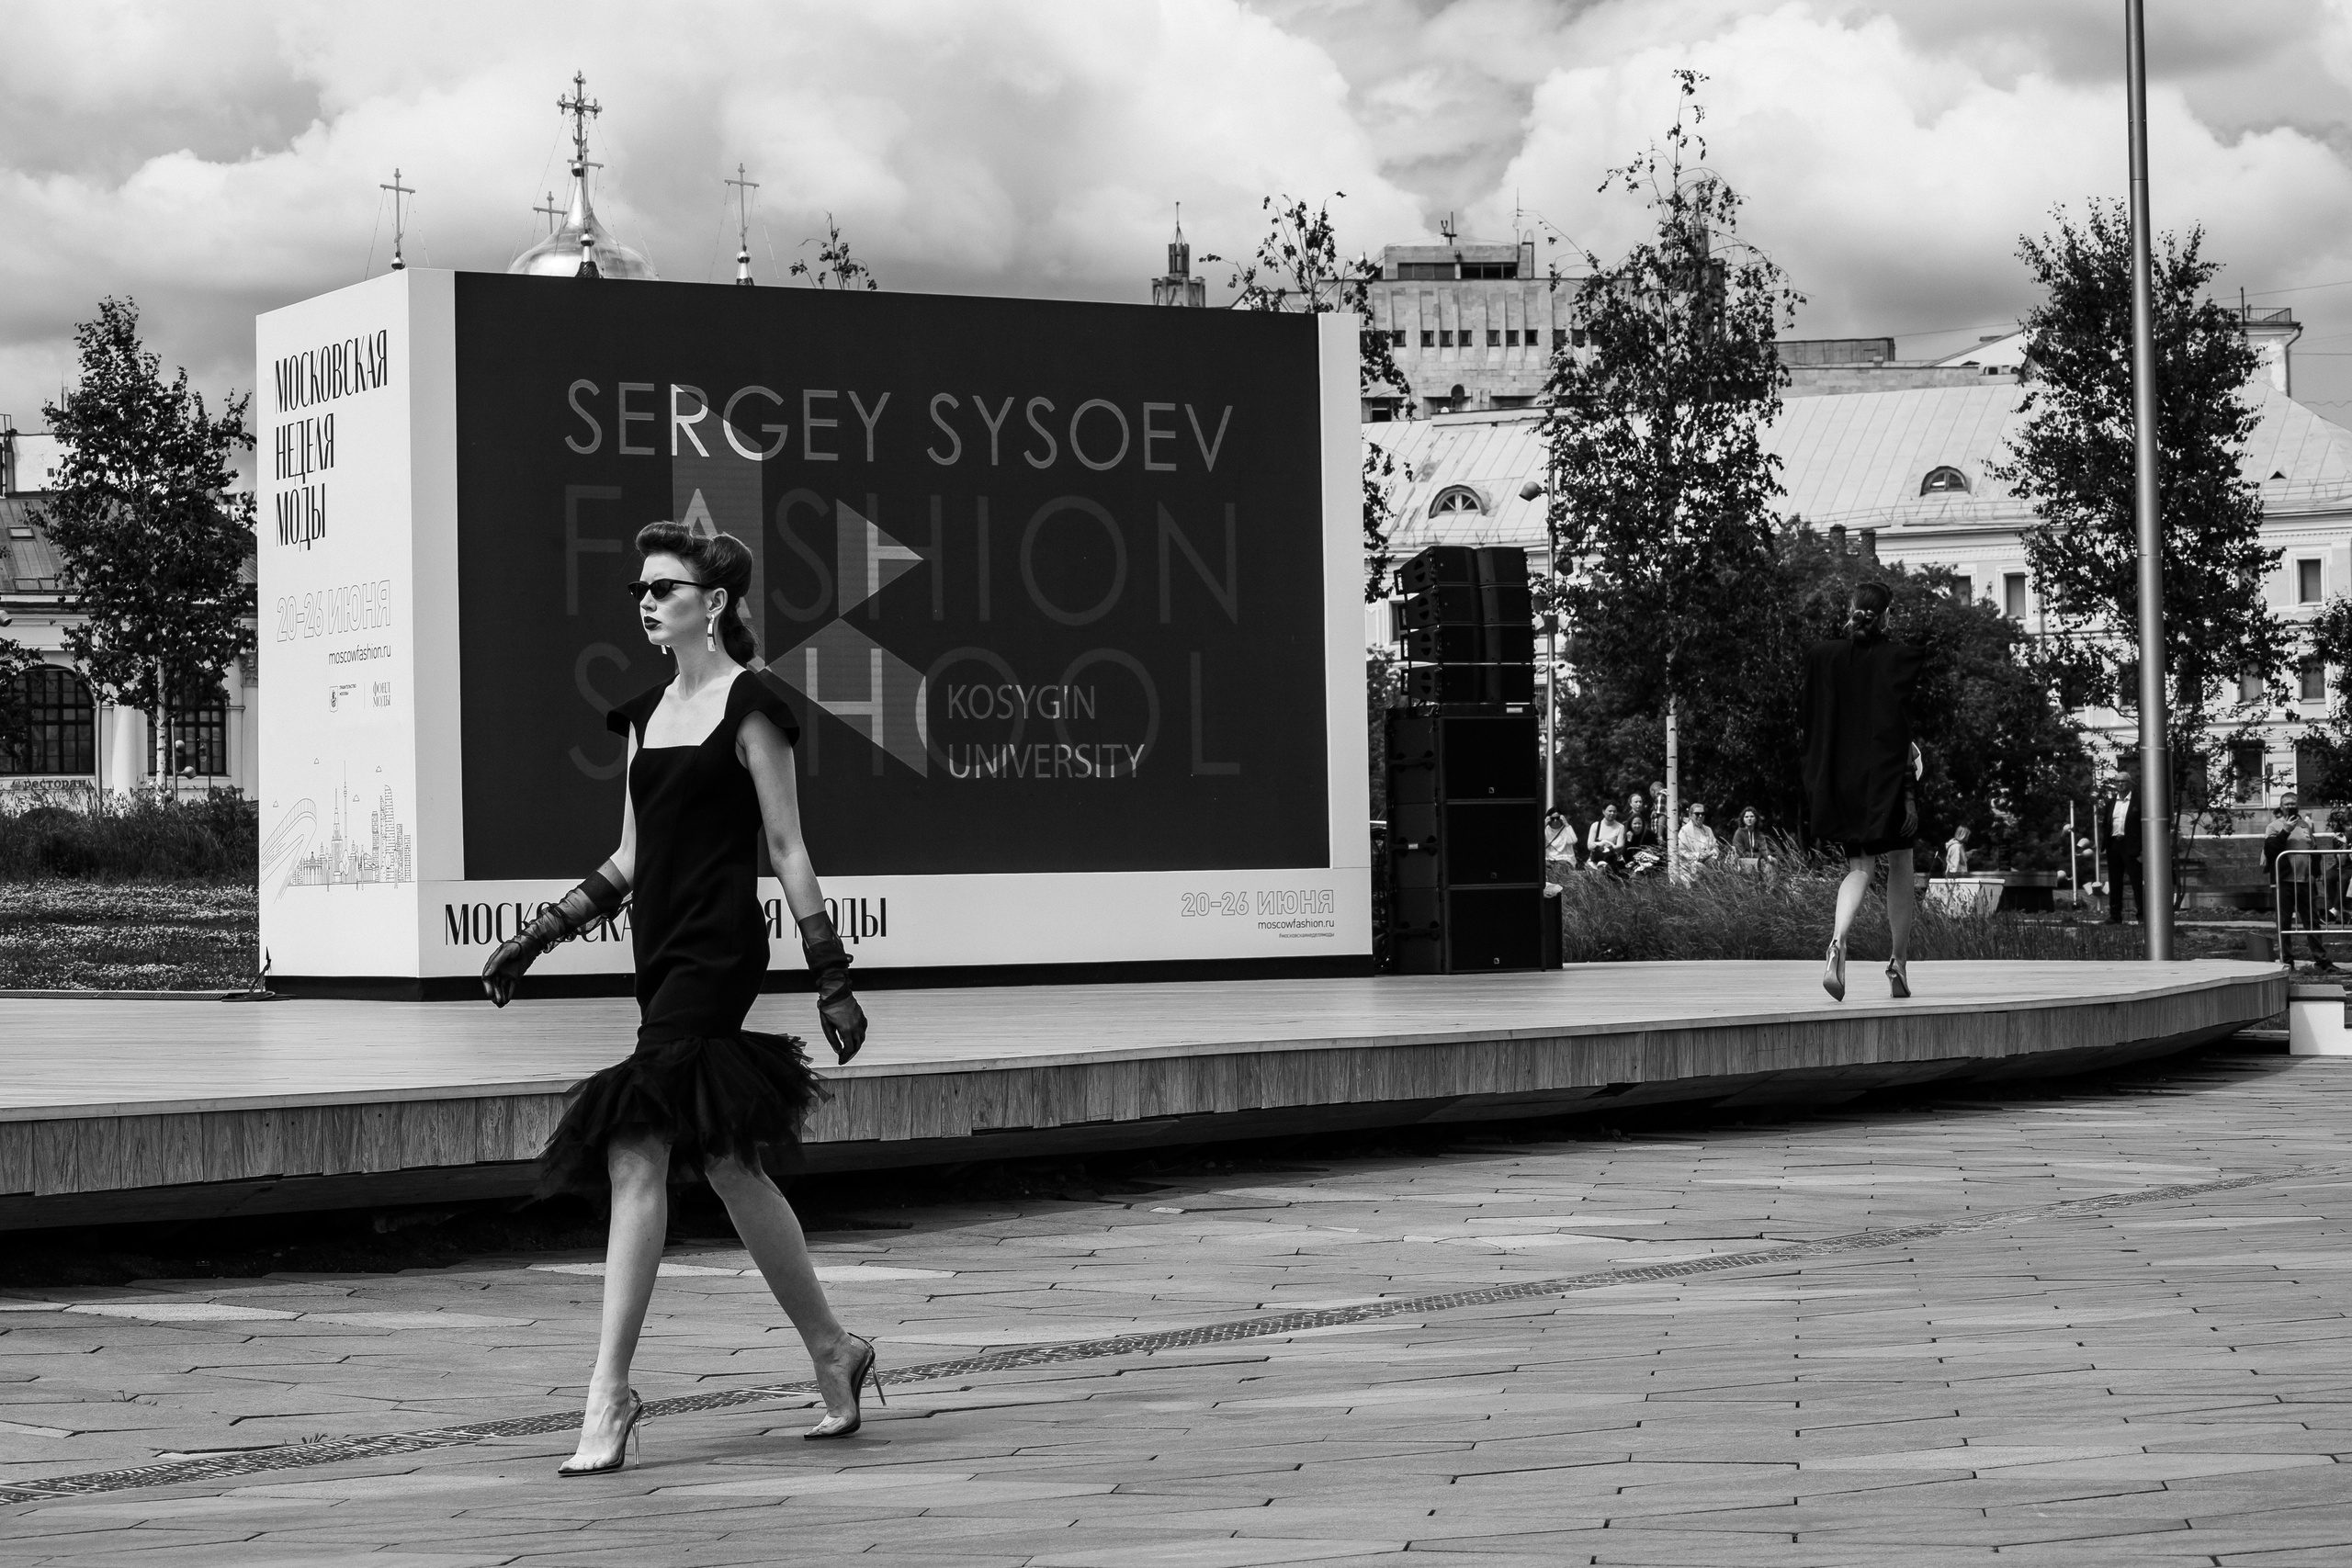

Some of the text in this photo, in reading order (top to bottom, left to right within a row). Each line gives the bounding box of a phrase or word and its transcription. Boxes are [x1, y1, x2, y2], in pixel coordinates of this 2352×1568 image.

[276, 329, 387, 413] МОСКОВСКАЯ
[276, 412, 334, 485] НЕДЕЛЯ
[564, 378, 1233, 472] SERGEY SYSOEV
[276, 482, 325, 551] МОДЫ
[277, 580, 390, 642] 20-26 ИЮНЯ
[328, 643, 391, 665] moscowfashion.ru
[569, 643, 1240, 781] SHOOL
[948, 683, 1095, 719] KOSYGIN
[948, 743, 1145, 779] UNIVERSITY
[23, 779, 86, 791] ресторан
[795, 897, 887, 944] ОДЫ
[1181, 889, 1334, 917] 20-26 ИЮНЯ
[1258, 919, 1335, 930] moscowfashion.ru
